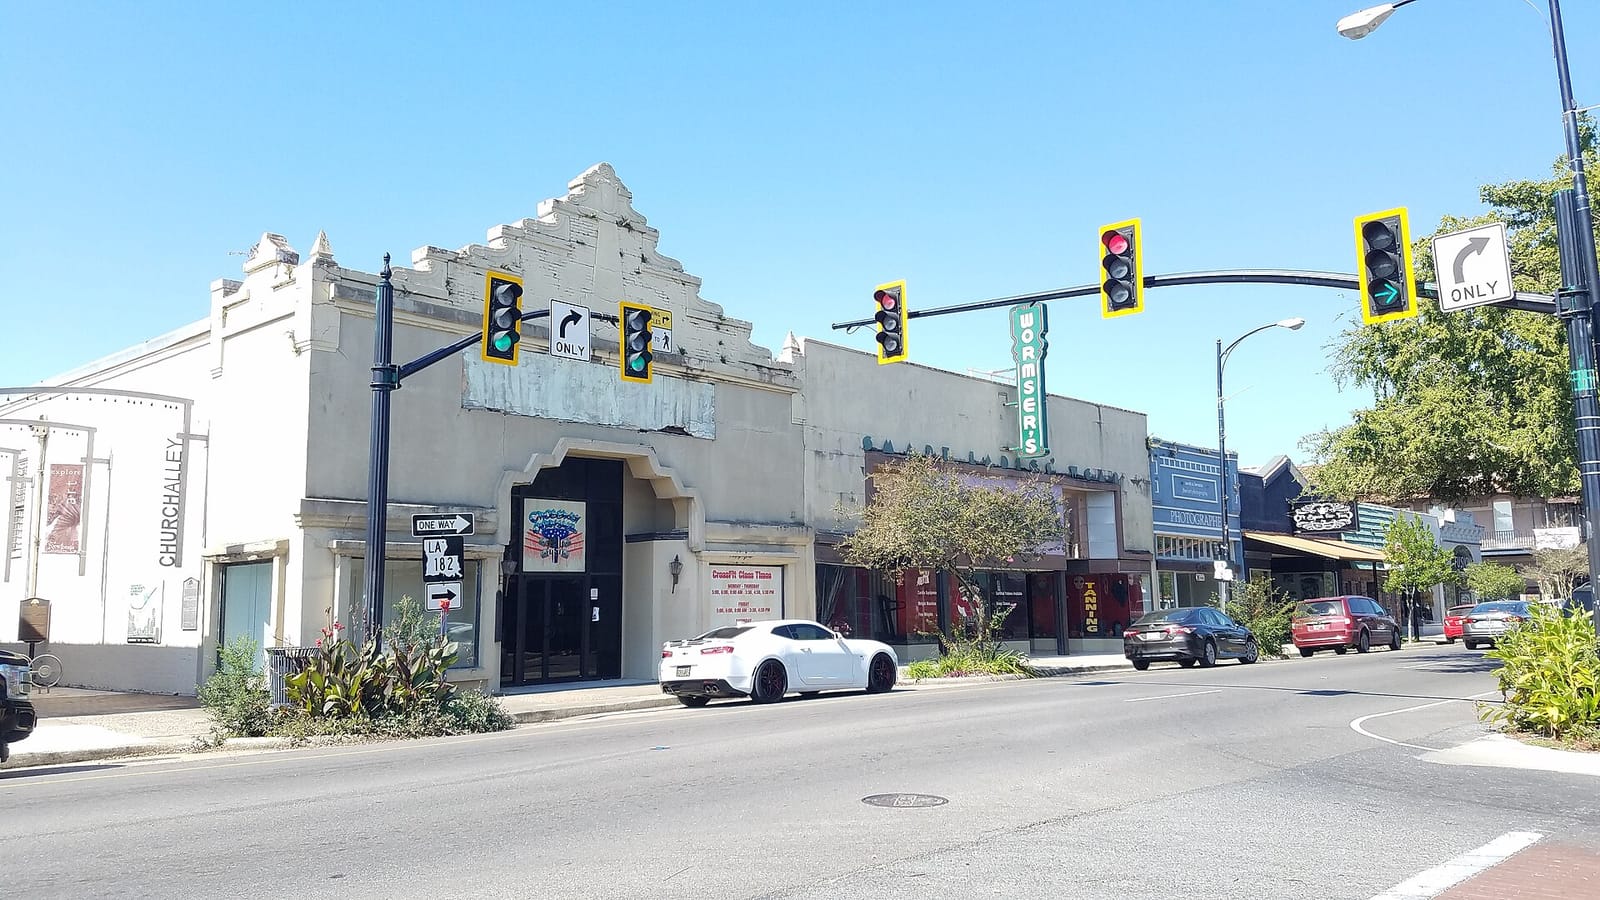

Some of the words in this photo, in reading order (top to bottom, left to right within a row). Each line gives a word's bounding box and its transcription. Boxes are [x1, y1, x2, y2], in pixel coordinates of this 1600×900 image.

[1451, 280, 1498, 302] ONLY
[556, 341, 585, 357] ONLY
[1019, 311, 1037, 454] WORMSER'S
[66, 480, 78, 505] art
[418, 521, 435, 530] ONE
[437, 520, 455, 529] WAY
[1170, 511, 1221, 527] PHOTOGRAPHE
[428, 541, 441, 553] LA
[434, 557, 453, 571] 182
[738, 570, 754, 579] Class
[755, 571, 772, 579] Times
[1085, 582, 1098, 632] TANNING
